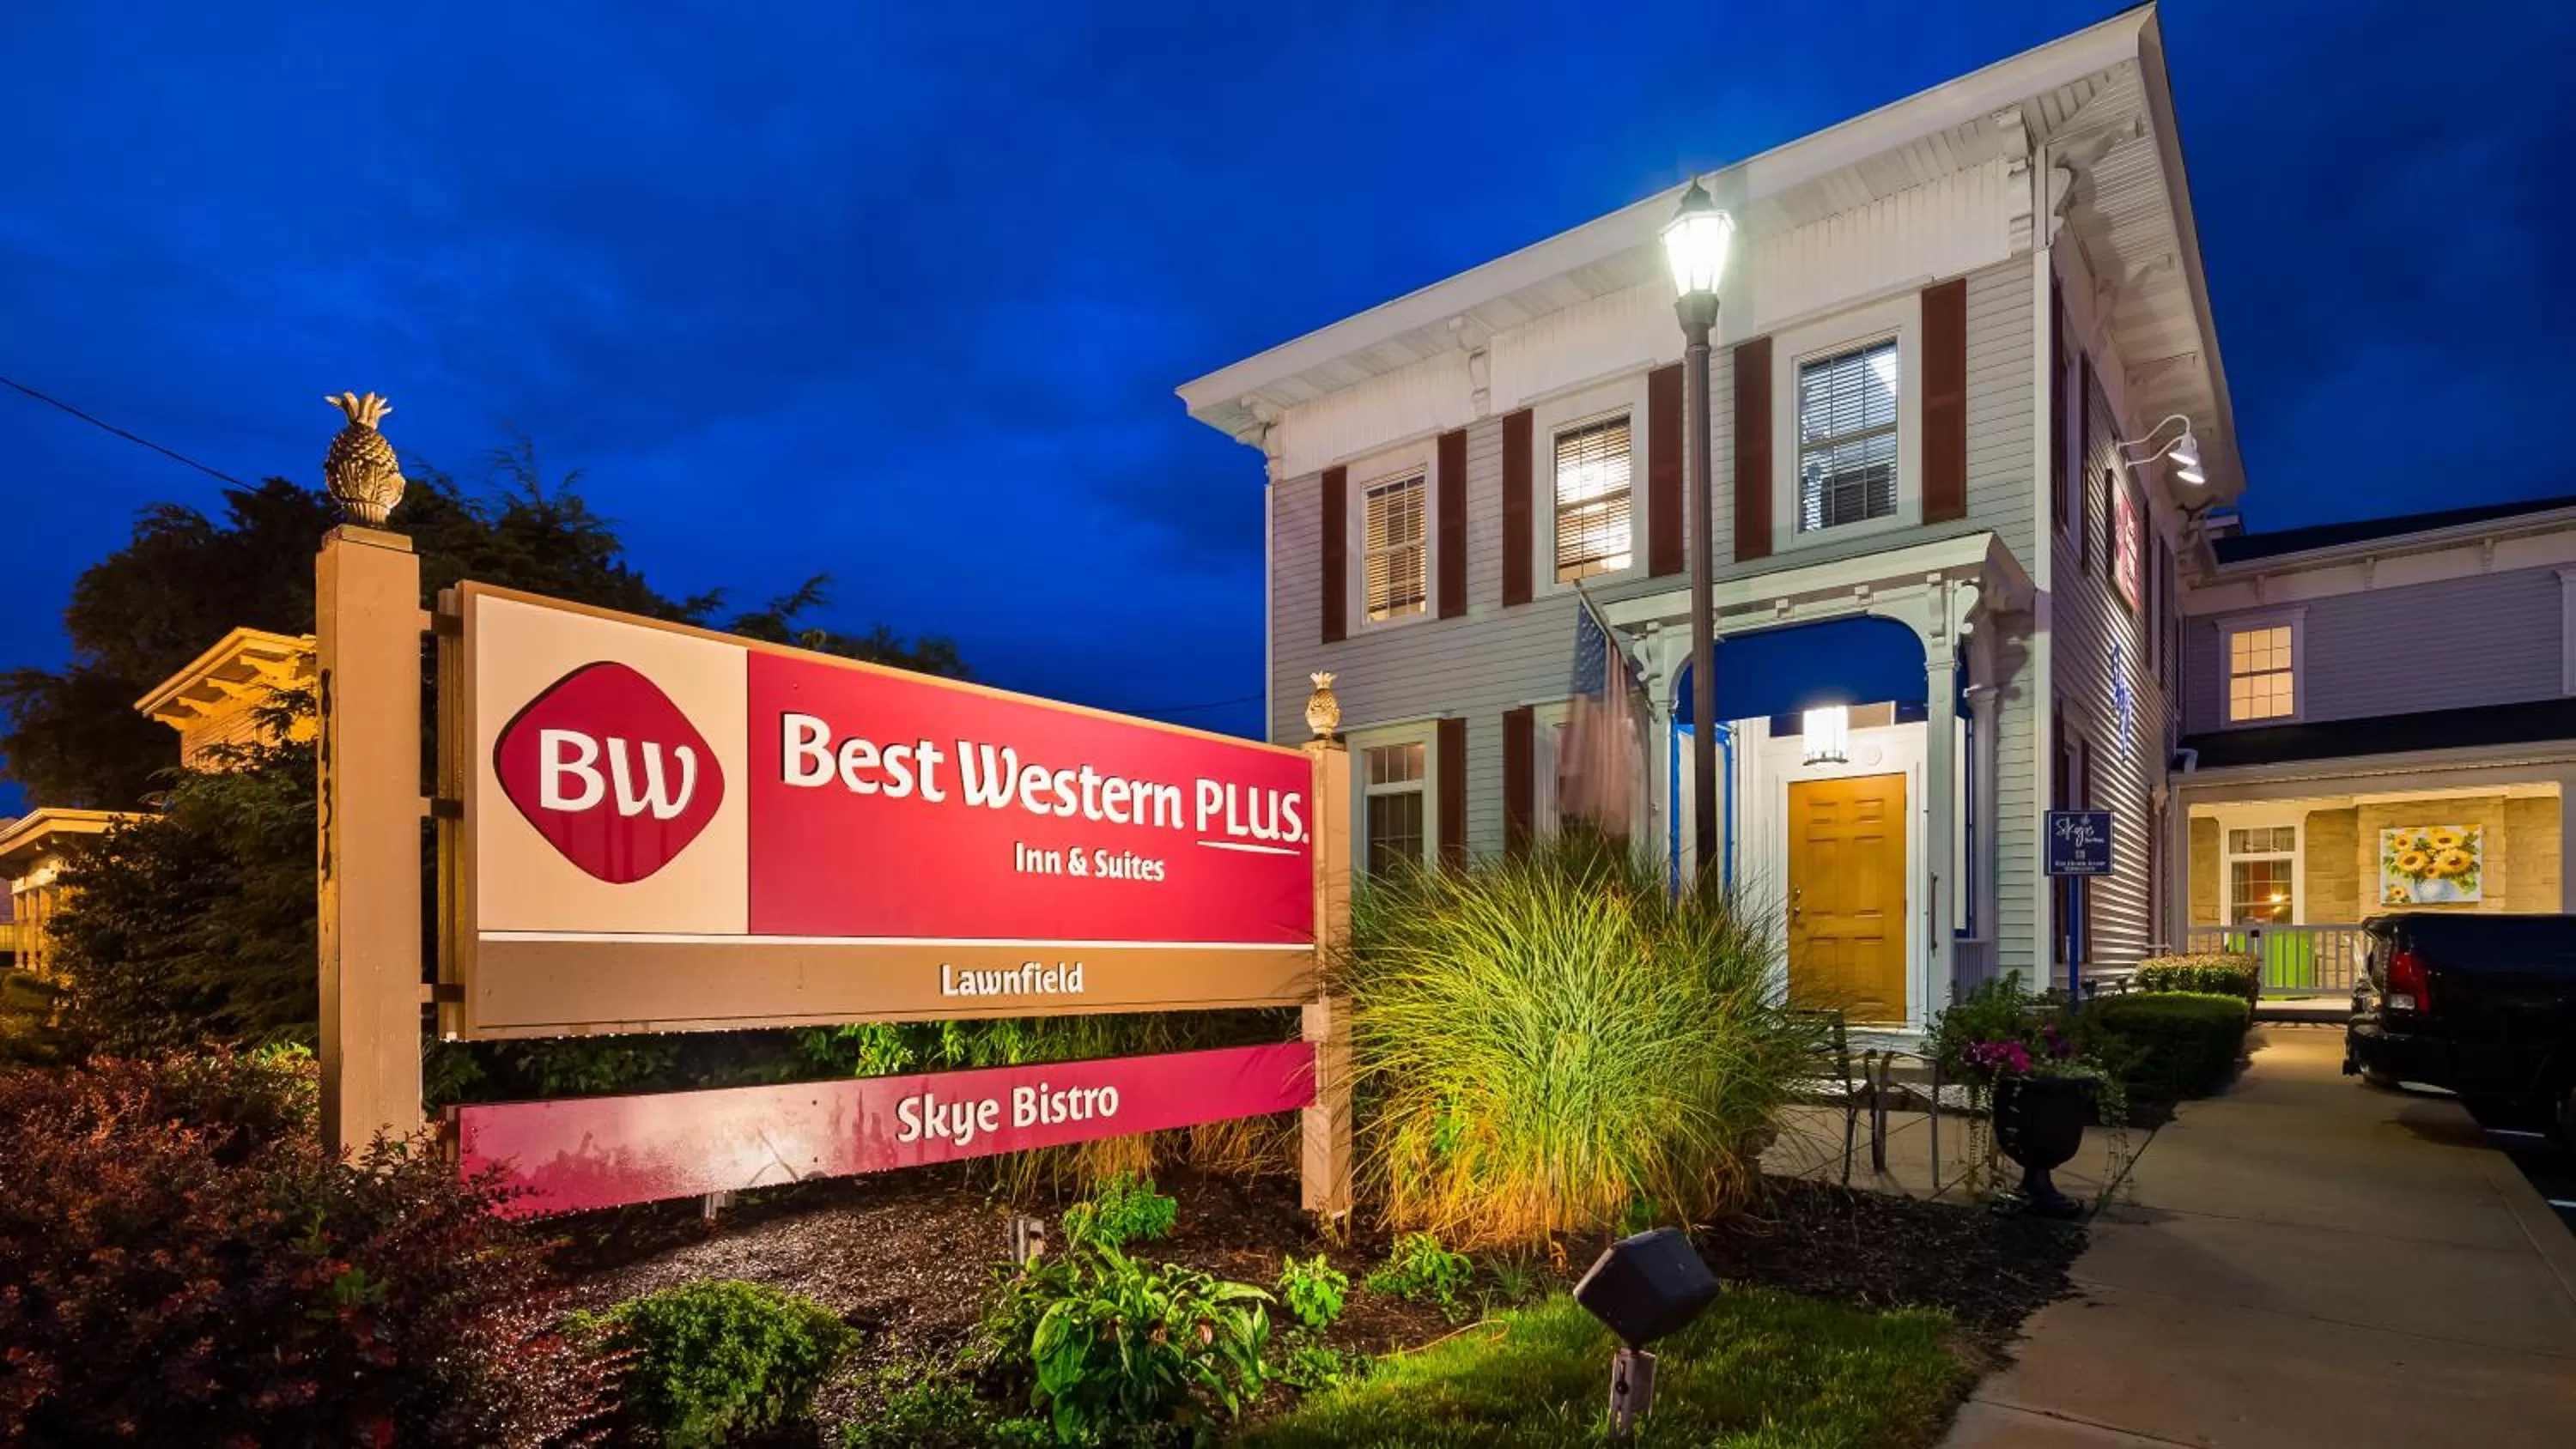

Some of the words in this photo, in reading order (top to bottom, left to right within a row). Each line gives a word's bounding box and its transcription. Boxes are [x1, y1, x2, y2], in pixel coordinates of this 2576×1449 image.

[539, 729, 697, 821] BW
[781, 712, 948, 803] Best
[958, 741, 1185, 831] Western
[1015, 841, 1063, 876] Inn
[1067, 846, 1090, 877] &
[1093, 849, 1166, 882] Suites
[940, 961, 1086, 998] Lawnfield
[896, 1093, 1001, 1147] Skye
[1012, 1082, 1120, 1128] Bistro
